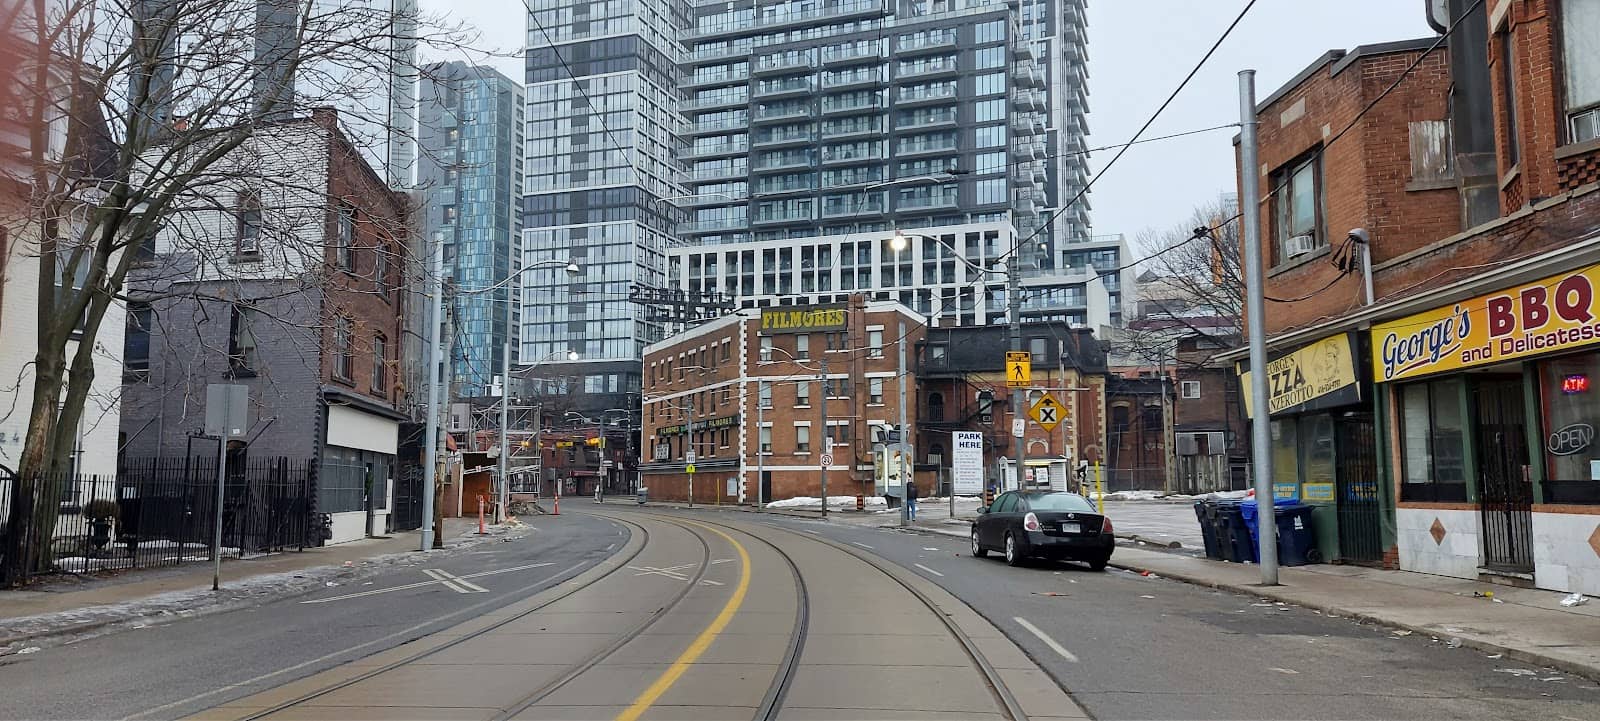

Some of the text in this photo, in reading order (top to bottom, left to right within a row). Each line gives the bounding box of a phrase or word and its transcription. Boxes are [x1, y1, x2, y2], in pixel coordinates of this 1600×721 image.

[762, 308, 844, 329] FILMORES
[1383, 274, 1594, 379] George's BBQ
[1462, 341, 1491, 363] and
[1271, 362, 1306, 397] ZZA
[1563, 377, 1584, 391] ATM
[1270, 384, 1314, 410] NZEROTTO
[959, 441, 982, 449] HERE
[1549, 428, 1590, 451] OPEN
